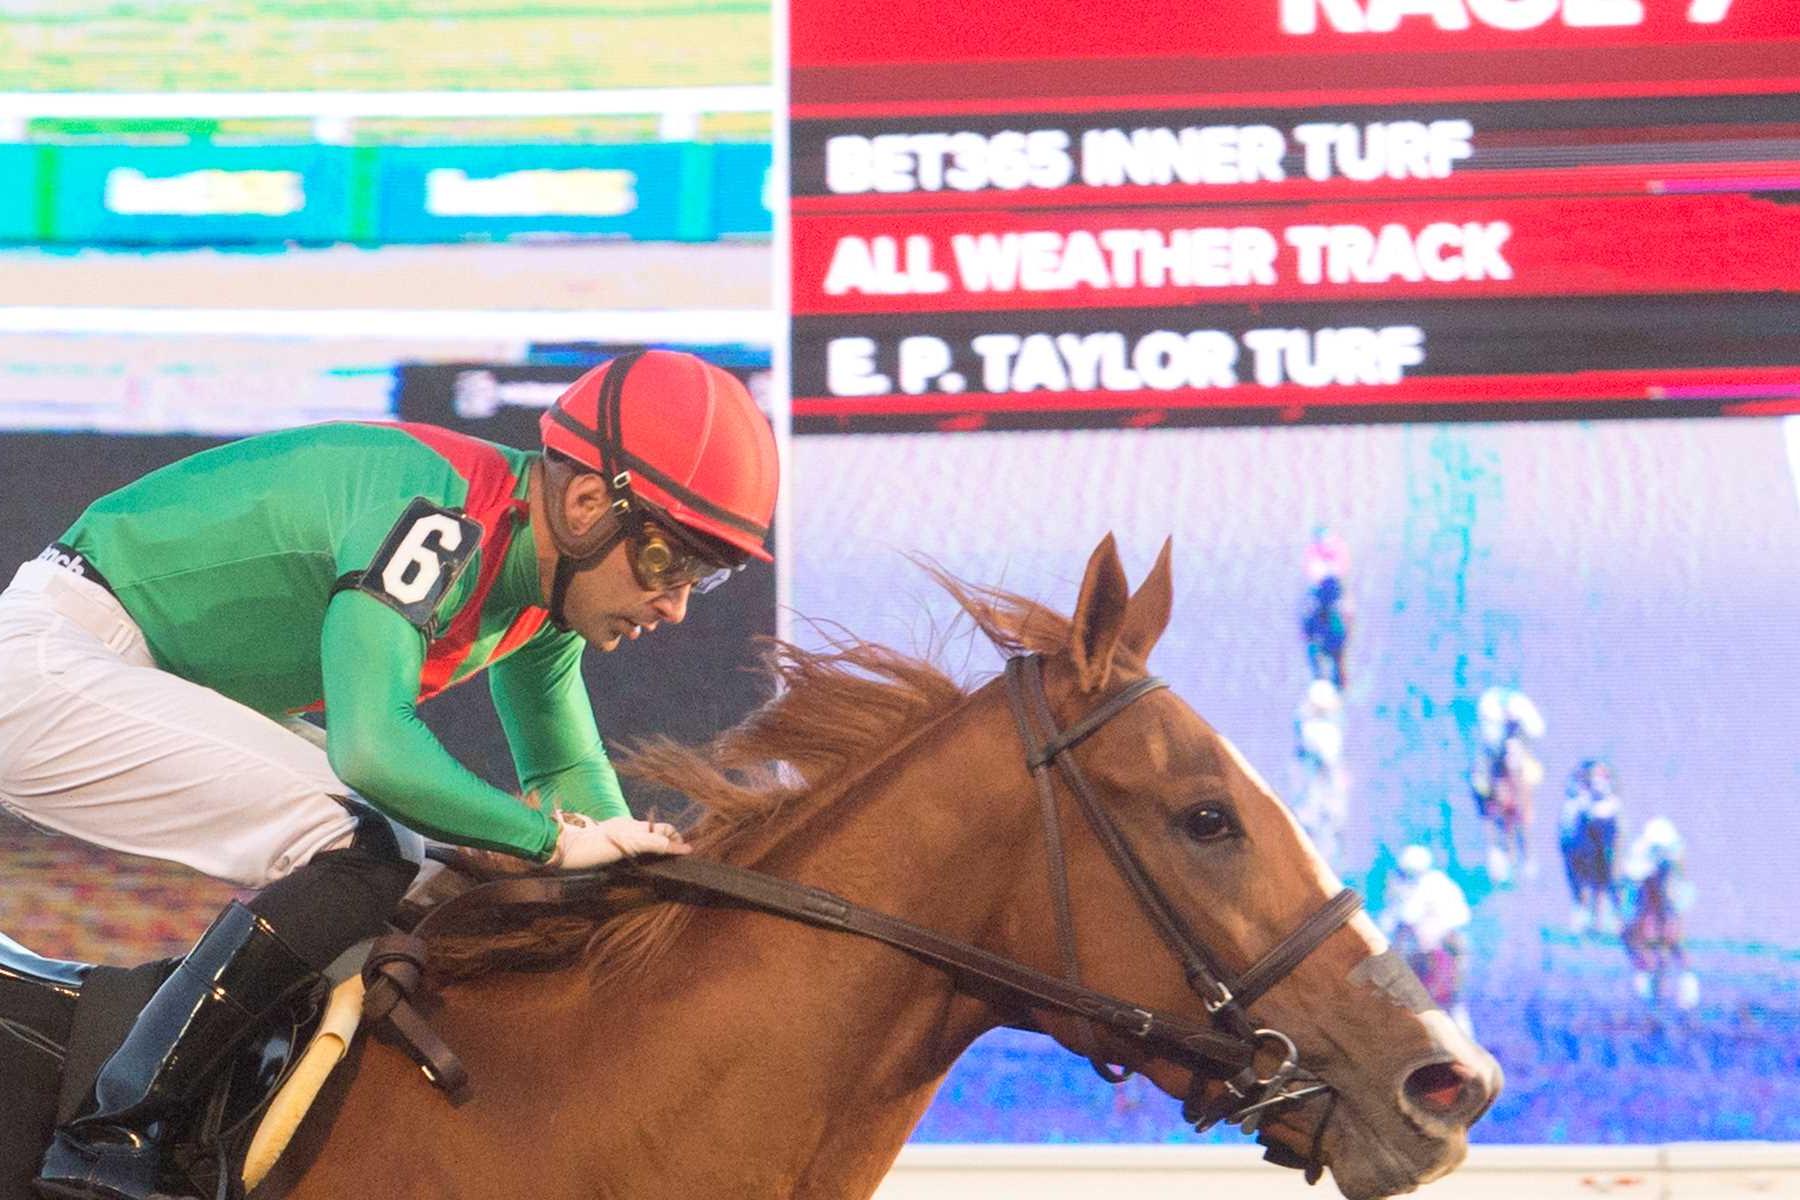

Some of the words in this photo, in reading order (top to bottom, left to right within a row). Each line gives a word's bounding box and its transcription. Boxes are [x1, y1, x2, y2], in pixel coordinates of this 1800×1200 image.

[826, 131, 1071, 193] BET365
[1082, 125, 1286, 186] INNER
[1294, 120, 1474, 179] TURF
[823, 234, 948, 295] ALL
[951, 227, 1277, 291] WEATHER
[1285, 220, 1514, 284] TRACK
[898, 335, 967, 395] P.
[973, 328, 1239, 392] TAYLOR
[1242, 325, 1427, 388] TURF
[381, 513, 462, 604] 6
